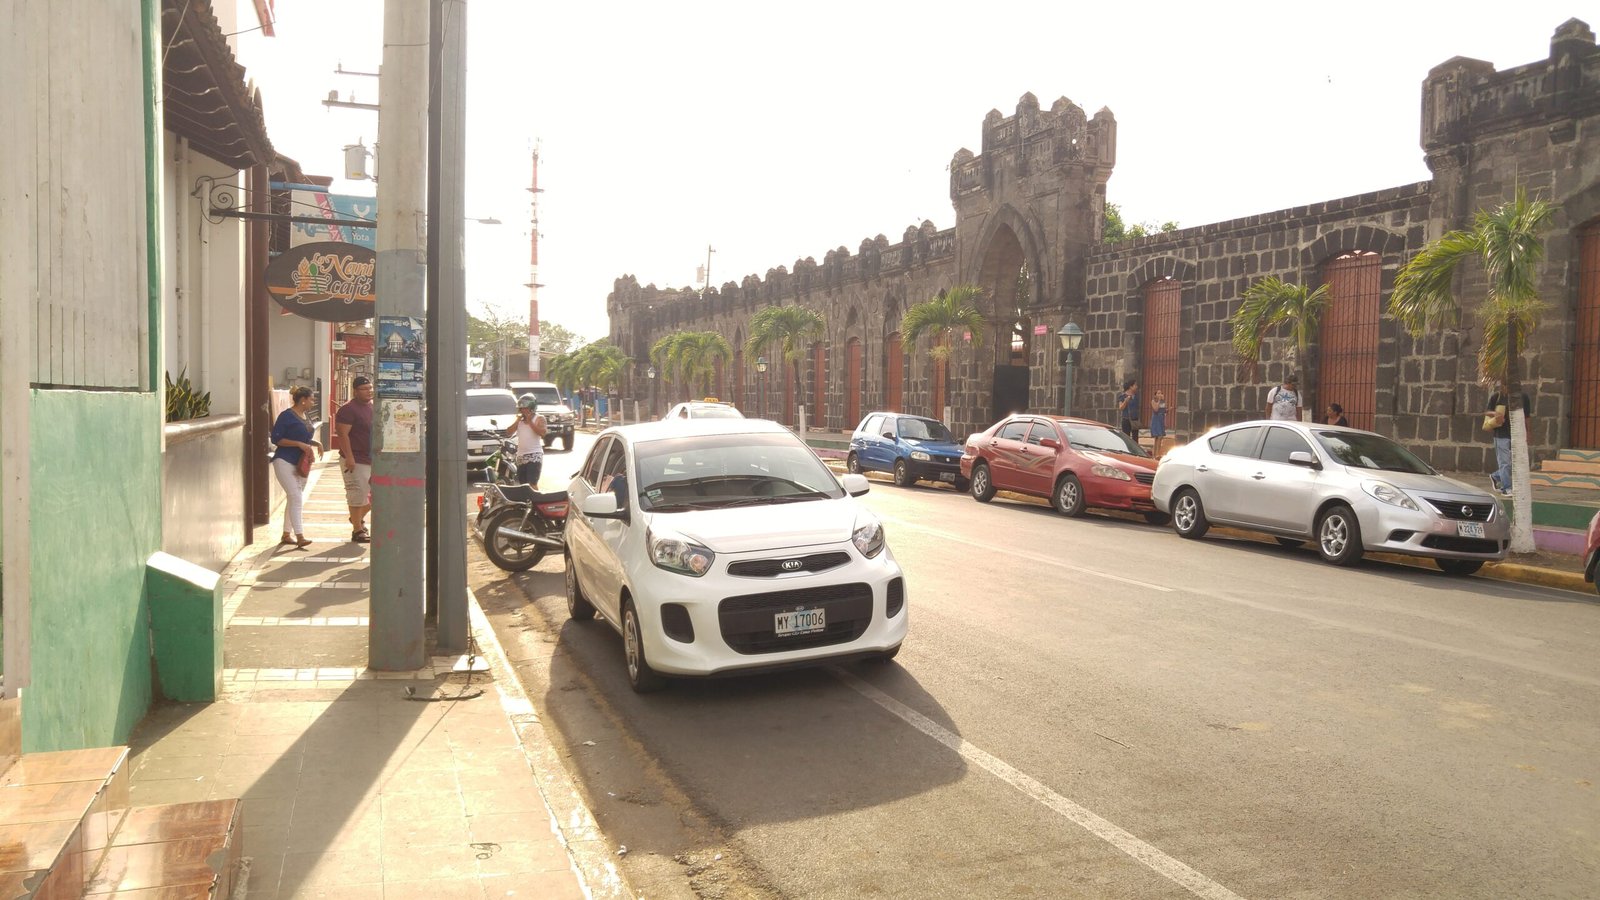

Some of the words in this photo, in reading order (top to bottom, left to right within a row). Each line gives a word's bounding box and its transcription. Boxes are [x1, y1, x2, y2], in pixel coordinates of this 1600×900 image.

[351, 232, 370, 241] Yota
[320, 255, 376, 283] Nani
[330, 274, 373, 304] café
[785, 561, 800, 569] KIA
[777, 616, 789, 630] MY
[794, 612, 824, 628] 17006
